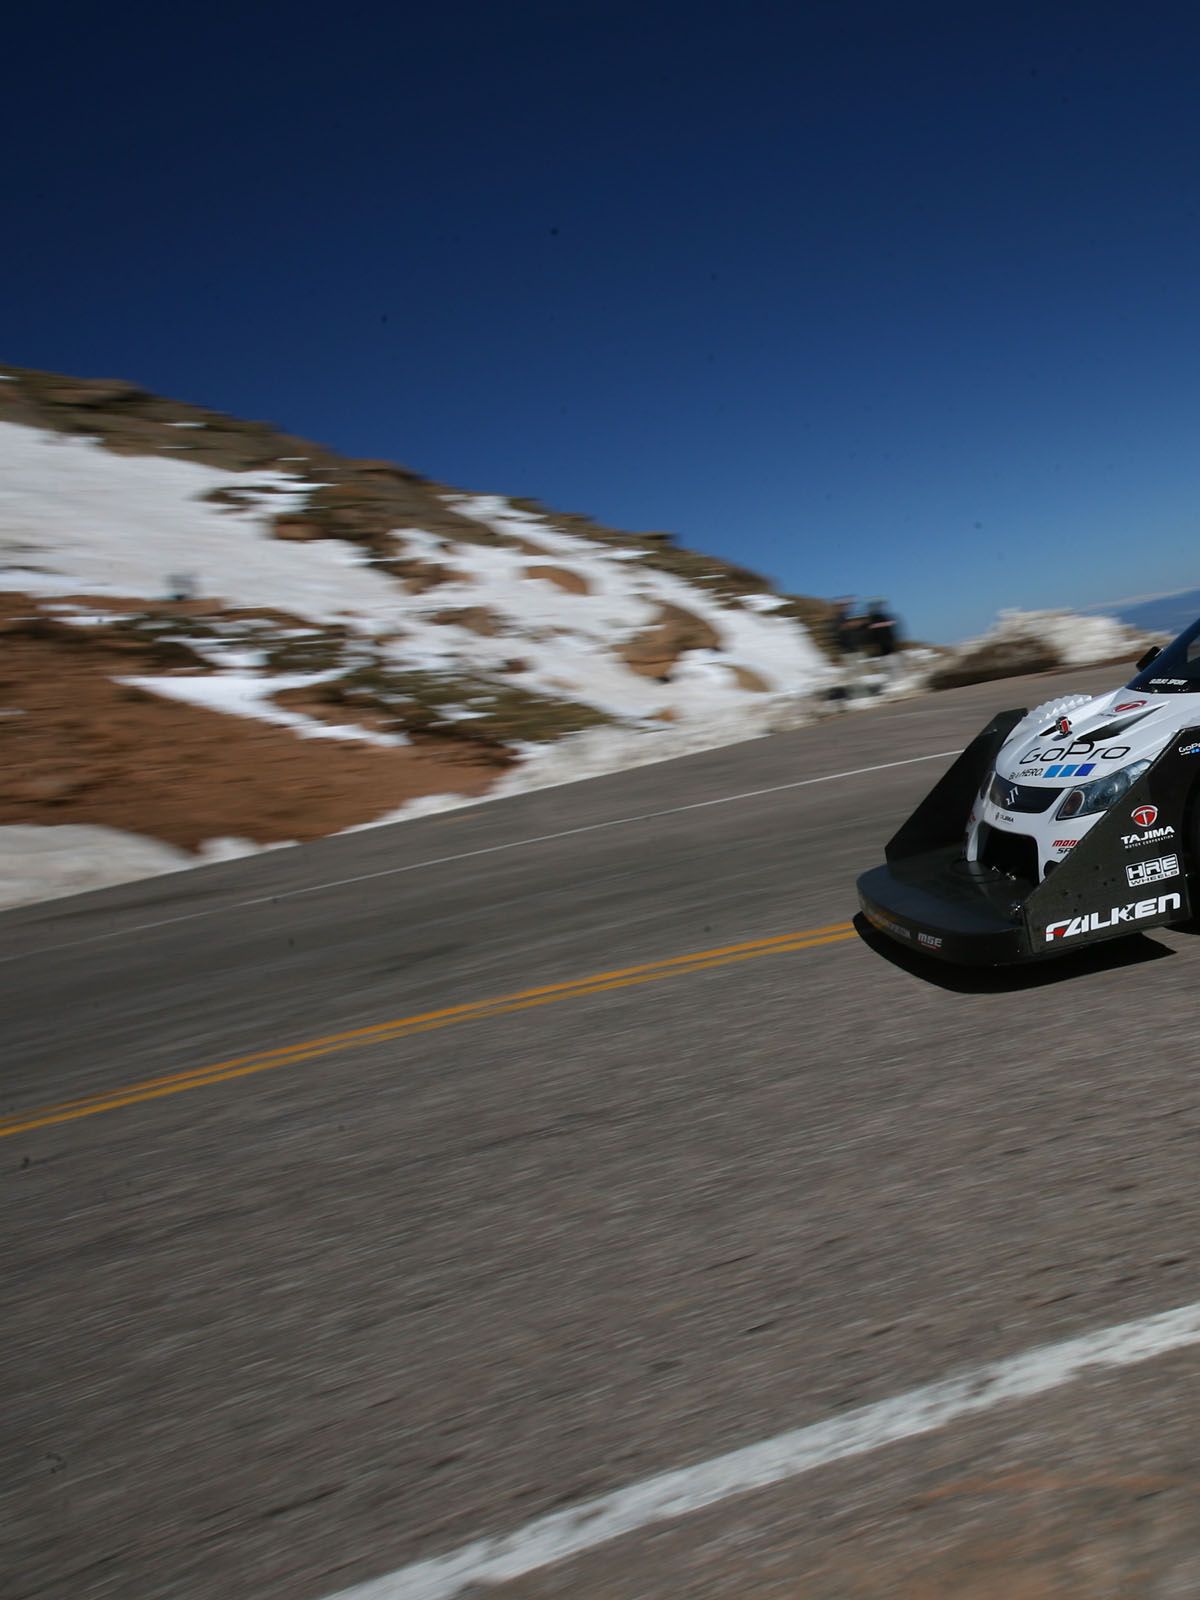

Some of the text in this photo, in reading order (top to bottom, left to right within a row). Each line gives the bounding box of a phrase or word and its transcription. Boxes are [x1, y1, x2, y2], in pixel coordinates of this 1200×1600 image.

[1019, 741, 1131, 765] GoPro
[1121, 825, 1175, 844] TAJIMA
[1127, 856, 1177, 880] HRE
[1130, 870, 1178, 885] WHEELS
[1044, 892, 1181, 942] FALKEN
